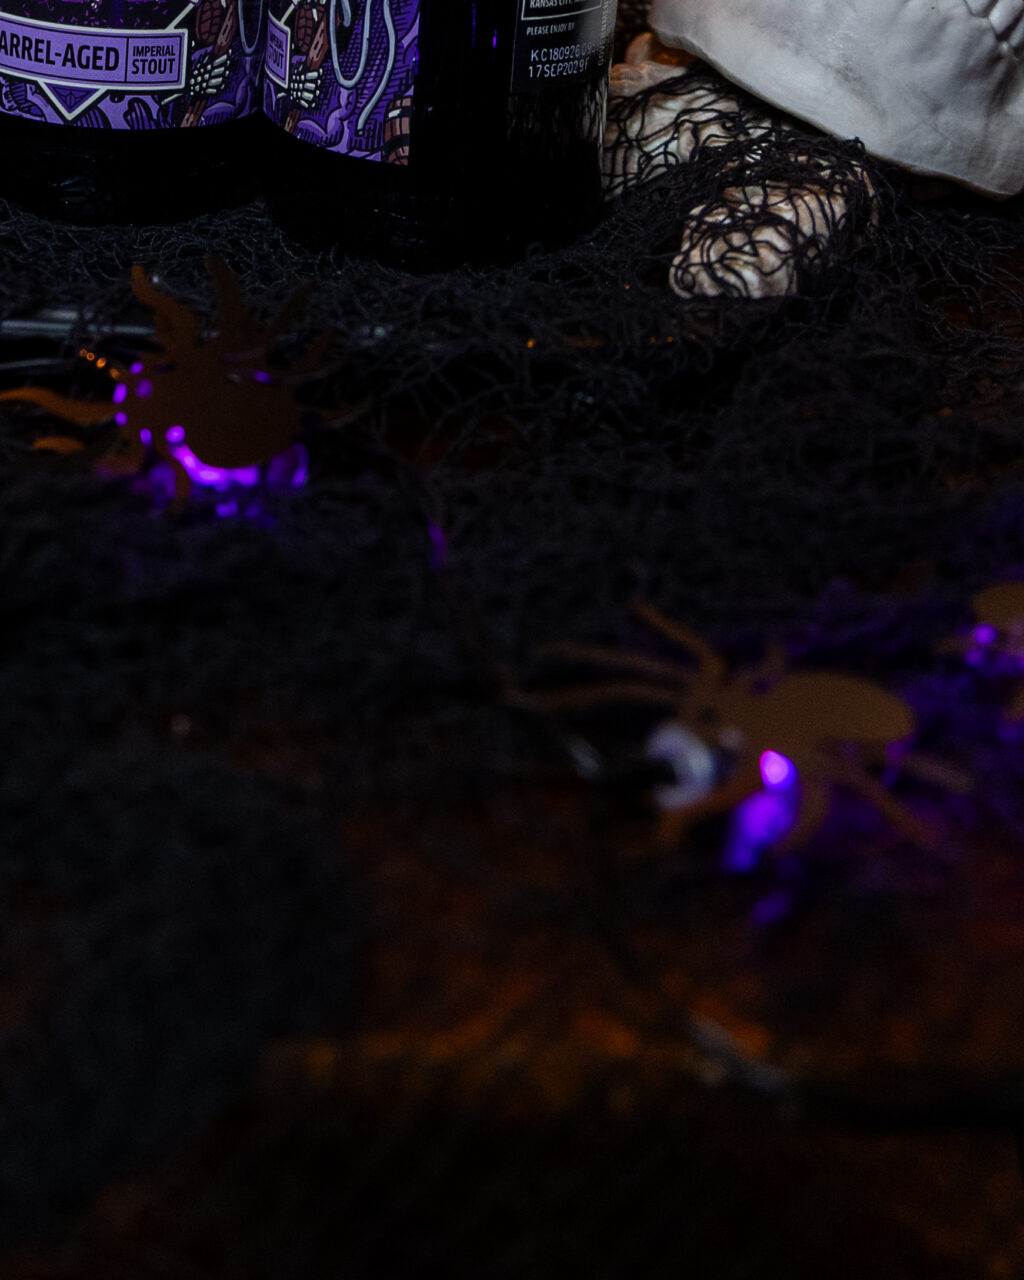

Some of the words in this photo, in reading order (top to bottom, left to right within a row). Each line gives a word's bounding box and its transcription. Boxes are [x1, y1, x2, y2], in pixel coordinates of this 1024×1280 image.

[526, 25, 549, 36] PLEASE
[132, 45, 176, 58] IMPERIAL
[131, 58, 176, 75] STOUT
